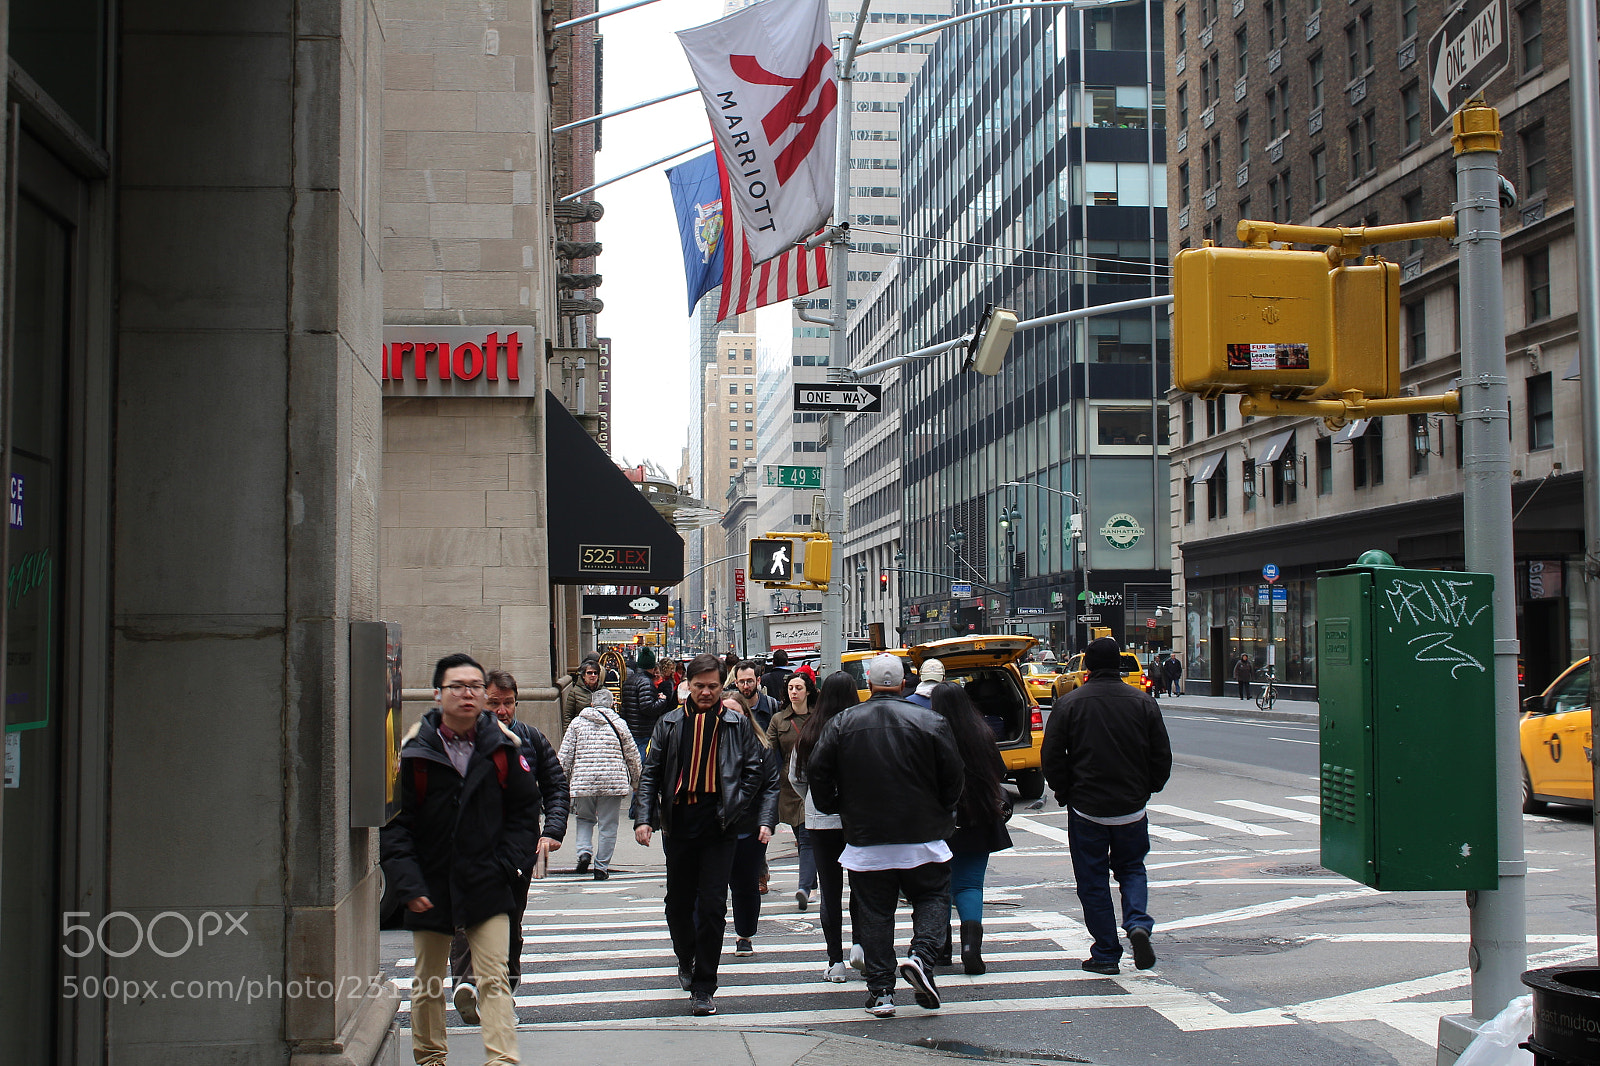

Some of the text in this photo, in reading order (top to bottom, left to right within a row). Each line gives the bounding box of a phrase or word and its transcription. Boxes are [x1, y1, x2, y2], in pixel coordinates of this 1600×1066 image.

[1446, 34, 1467, 86] ONE
[1471, 3, 1497, 61] WAY
[716, 90, 777, 232] MARRIOTT
[598, 343, 609, 406] HOTEL
[806, 391, 869, 404] ONE WAY
[778, 468, 820, 485] E 49 St
[1107, 515, 1138, 527] ATHLETIC
[1109, 538, 1137, 548] CLUB
[1540, 1008, 1558, 1025] east
